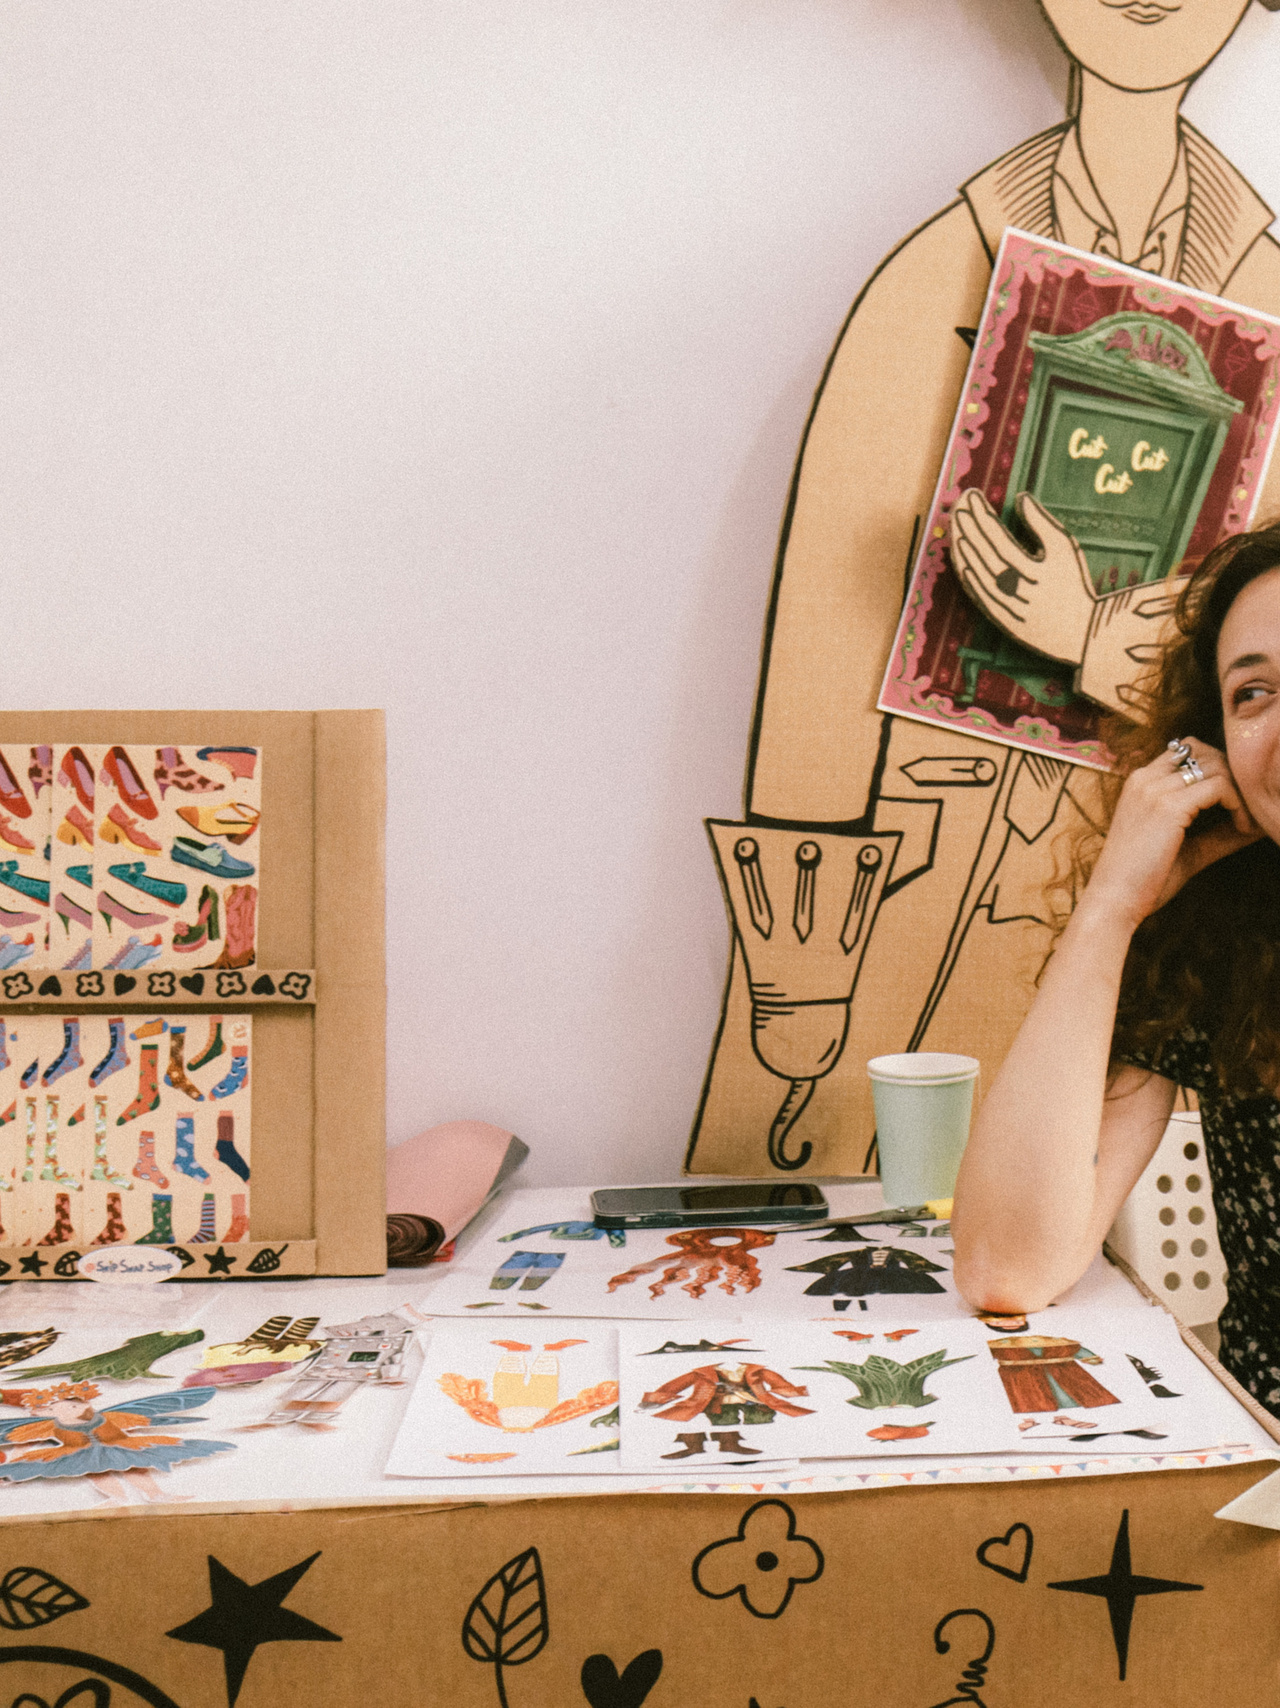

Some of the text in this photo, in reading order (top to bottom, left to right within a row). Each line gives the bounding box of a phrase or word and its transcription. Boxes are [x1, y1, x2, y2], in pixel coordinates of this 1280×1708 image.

[1068, 428, 1170, 472] Cut Cut
[1094, 463, 1134, 495] Cut
